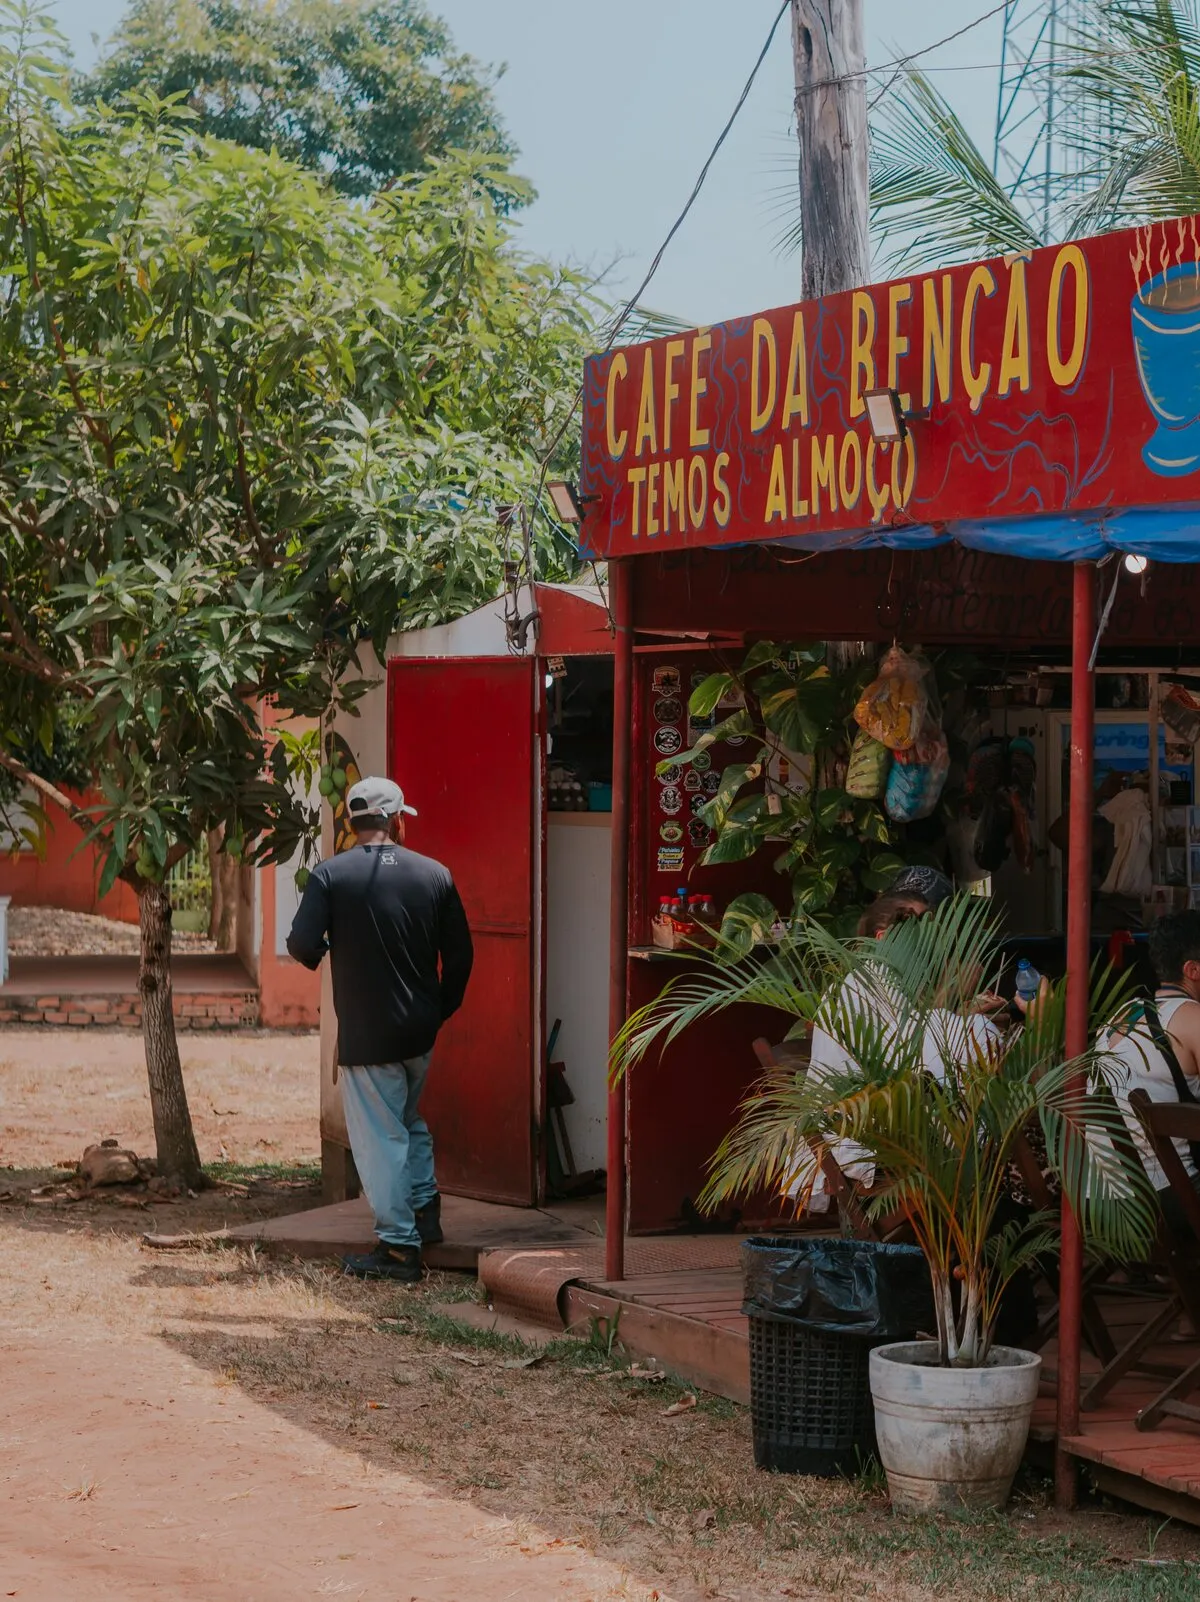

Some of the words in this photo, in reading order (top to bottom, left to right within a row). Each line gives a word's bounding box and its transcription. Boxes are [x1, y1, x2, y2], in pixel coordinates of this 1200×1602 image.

[606, 326, 711, 458] CAFÉ
[750, 311, 809, 432] DA
[850, 245, 1089, 417] BENÇÃO
[627, 452, 730, 537] TEMOS
[764, 429, 916, 522] ALMOÇO
